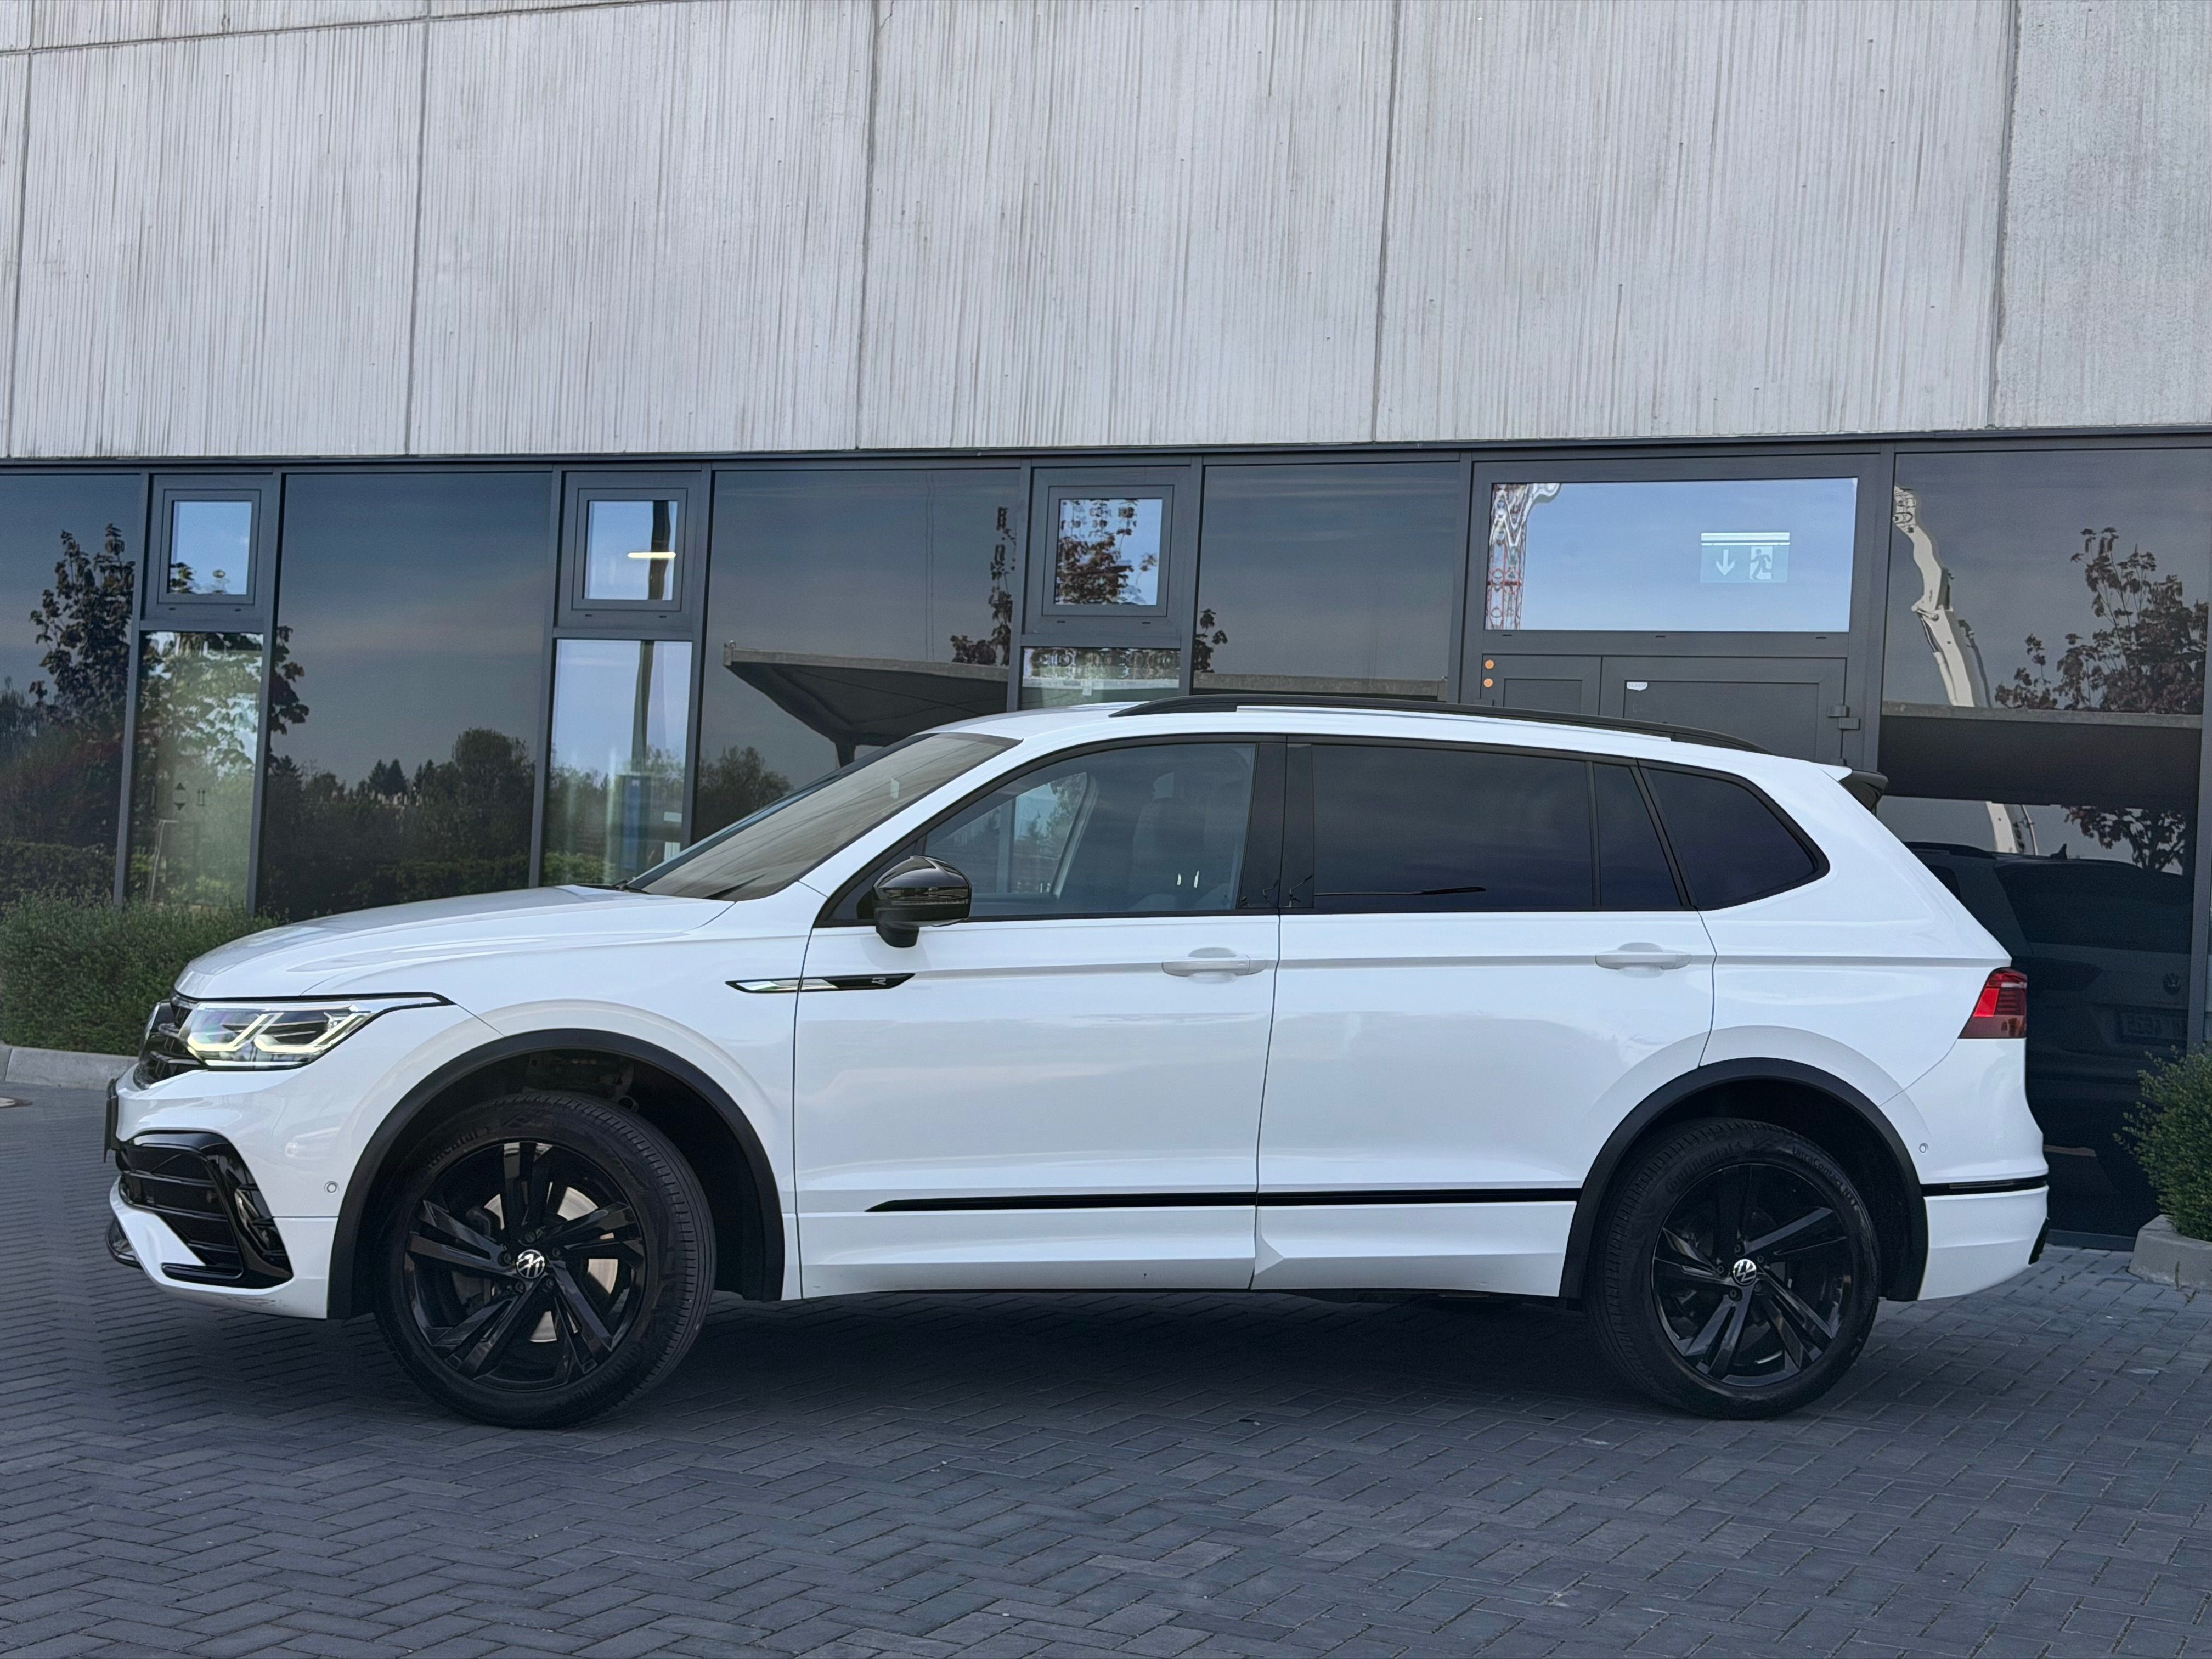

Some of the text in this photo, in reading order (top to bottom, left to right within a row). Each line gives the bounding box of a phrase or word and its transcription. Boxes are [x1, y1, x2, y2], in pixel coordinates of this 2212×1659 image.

[871, 977, 887, 985] R
[517, 1249, 545, 1279] VW
[1733, 1259, 1757, 1285] VW
